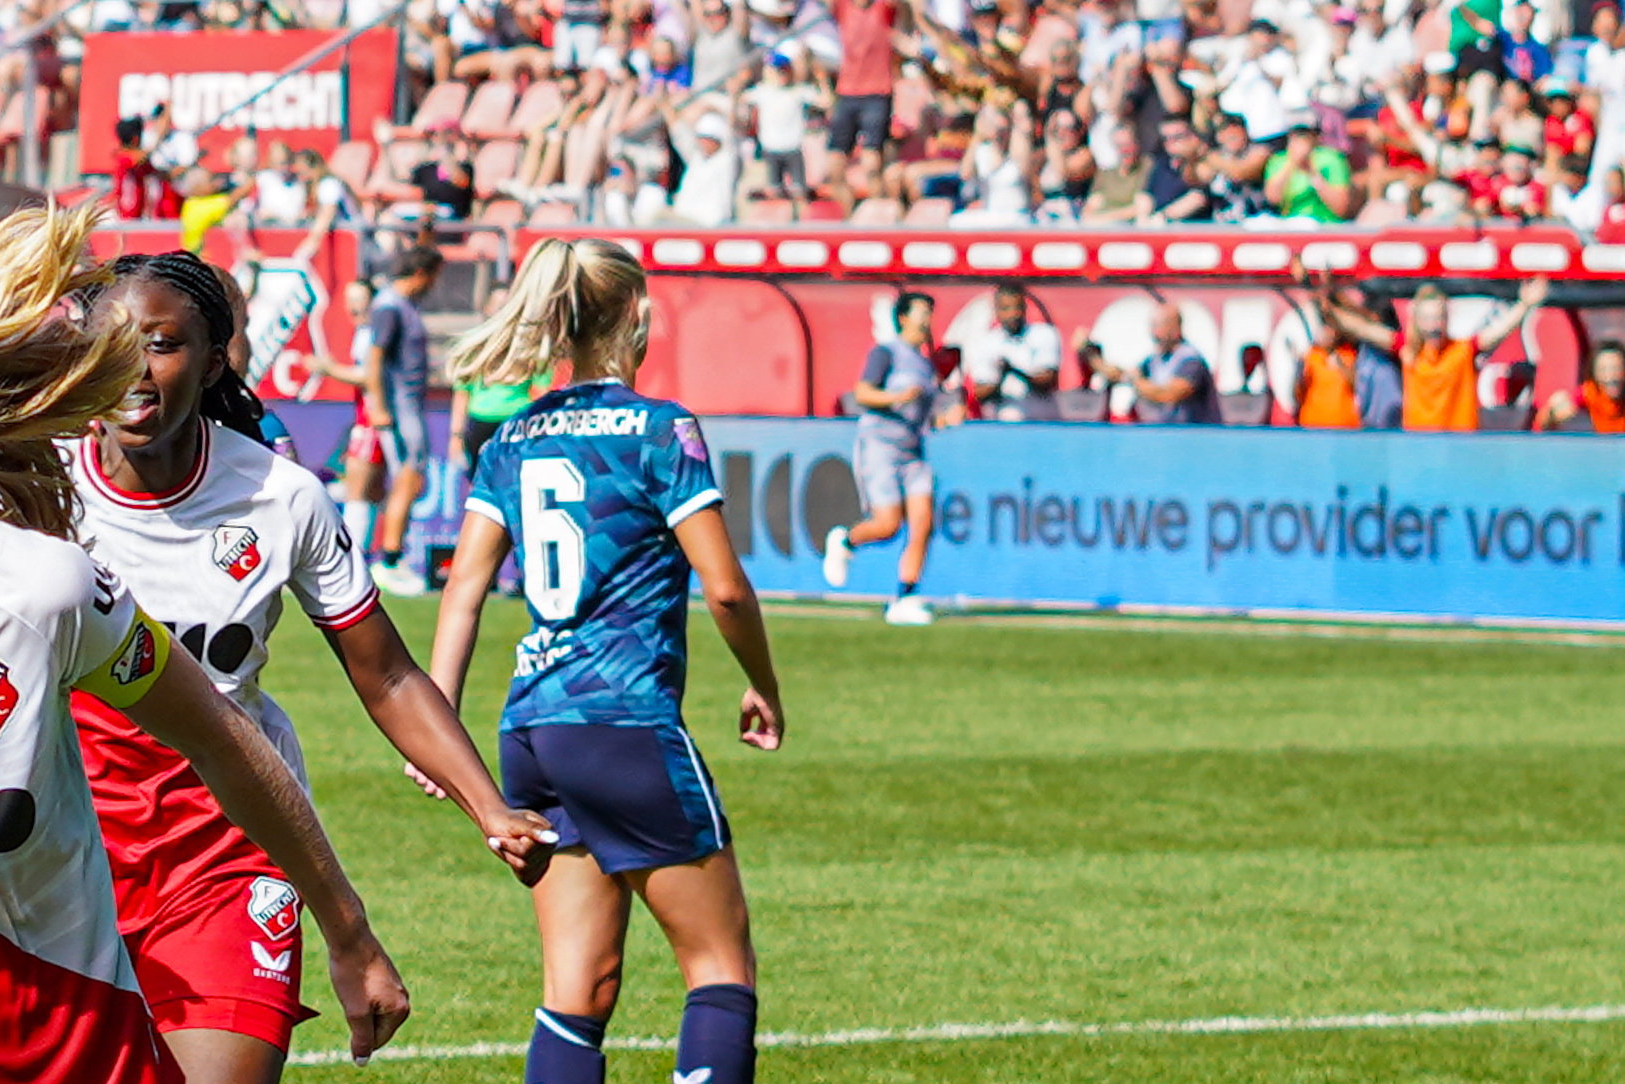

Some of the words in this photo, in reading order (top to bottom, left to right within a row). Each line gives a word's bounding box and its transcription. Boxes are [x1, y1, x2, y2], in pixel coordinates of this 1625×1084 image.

[172, 71, 342, 130] UTRECHT
[519, 457, 586, 620] 6
[987, 476, 1189, 551] nieuwe
[1206, 484, 1449, 574] provider
[1464, 504, 1603, 566] voor
